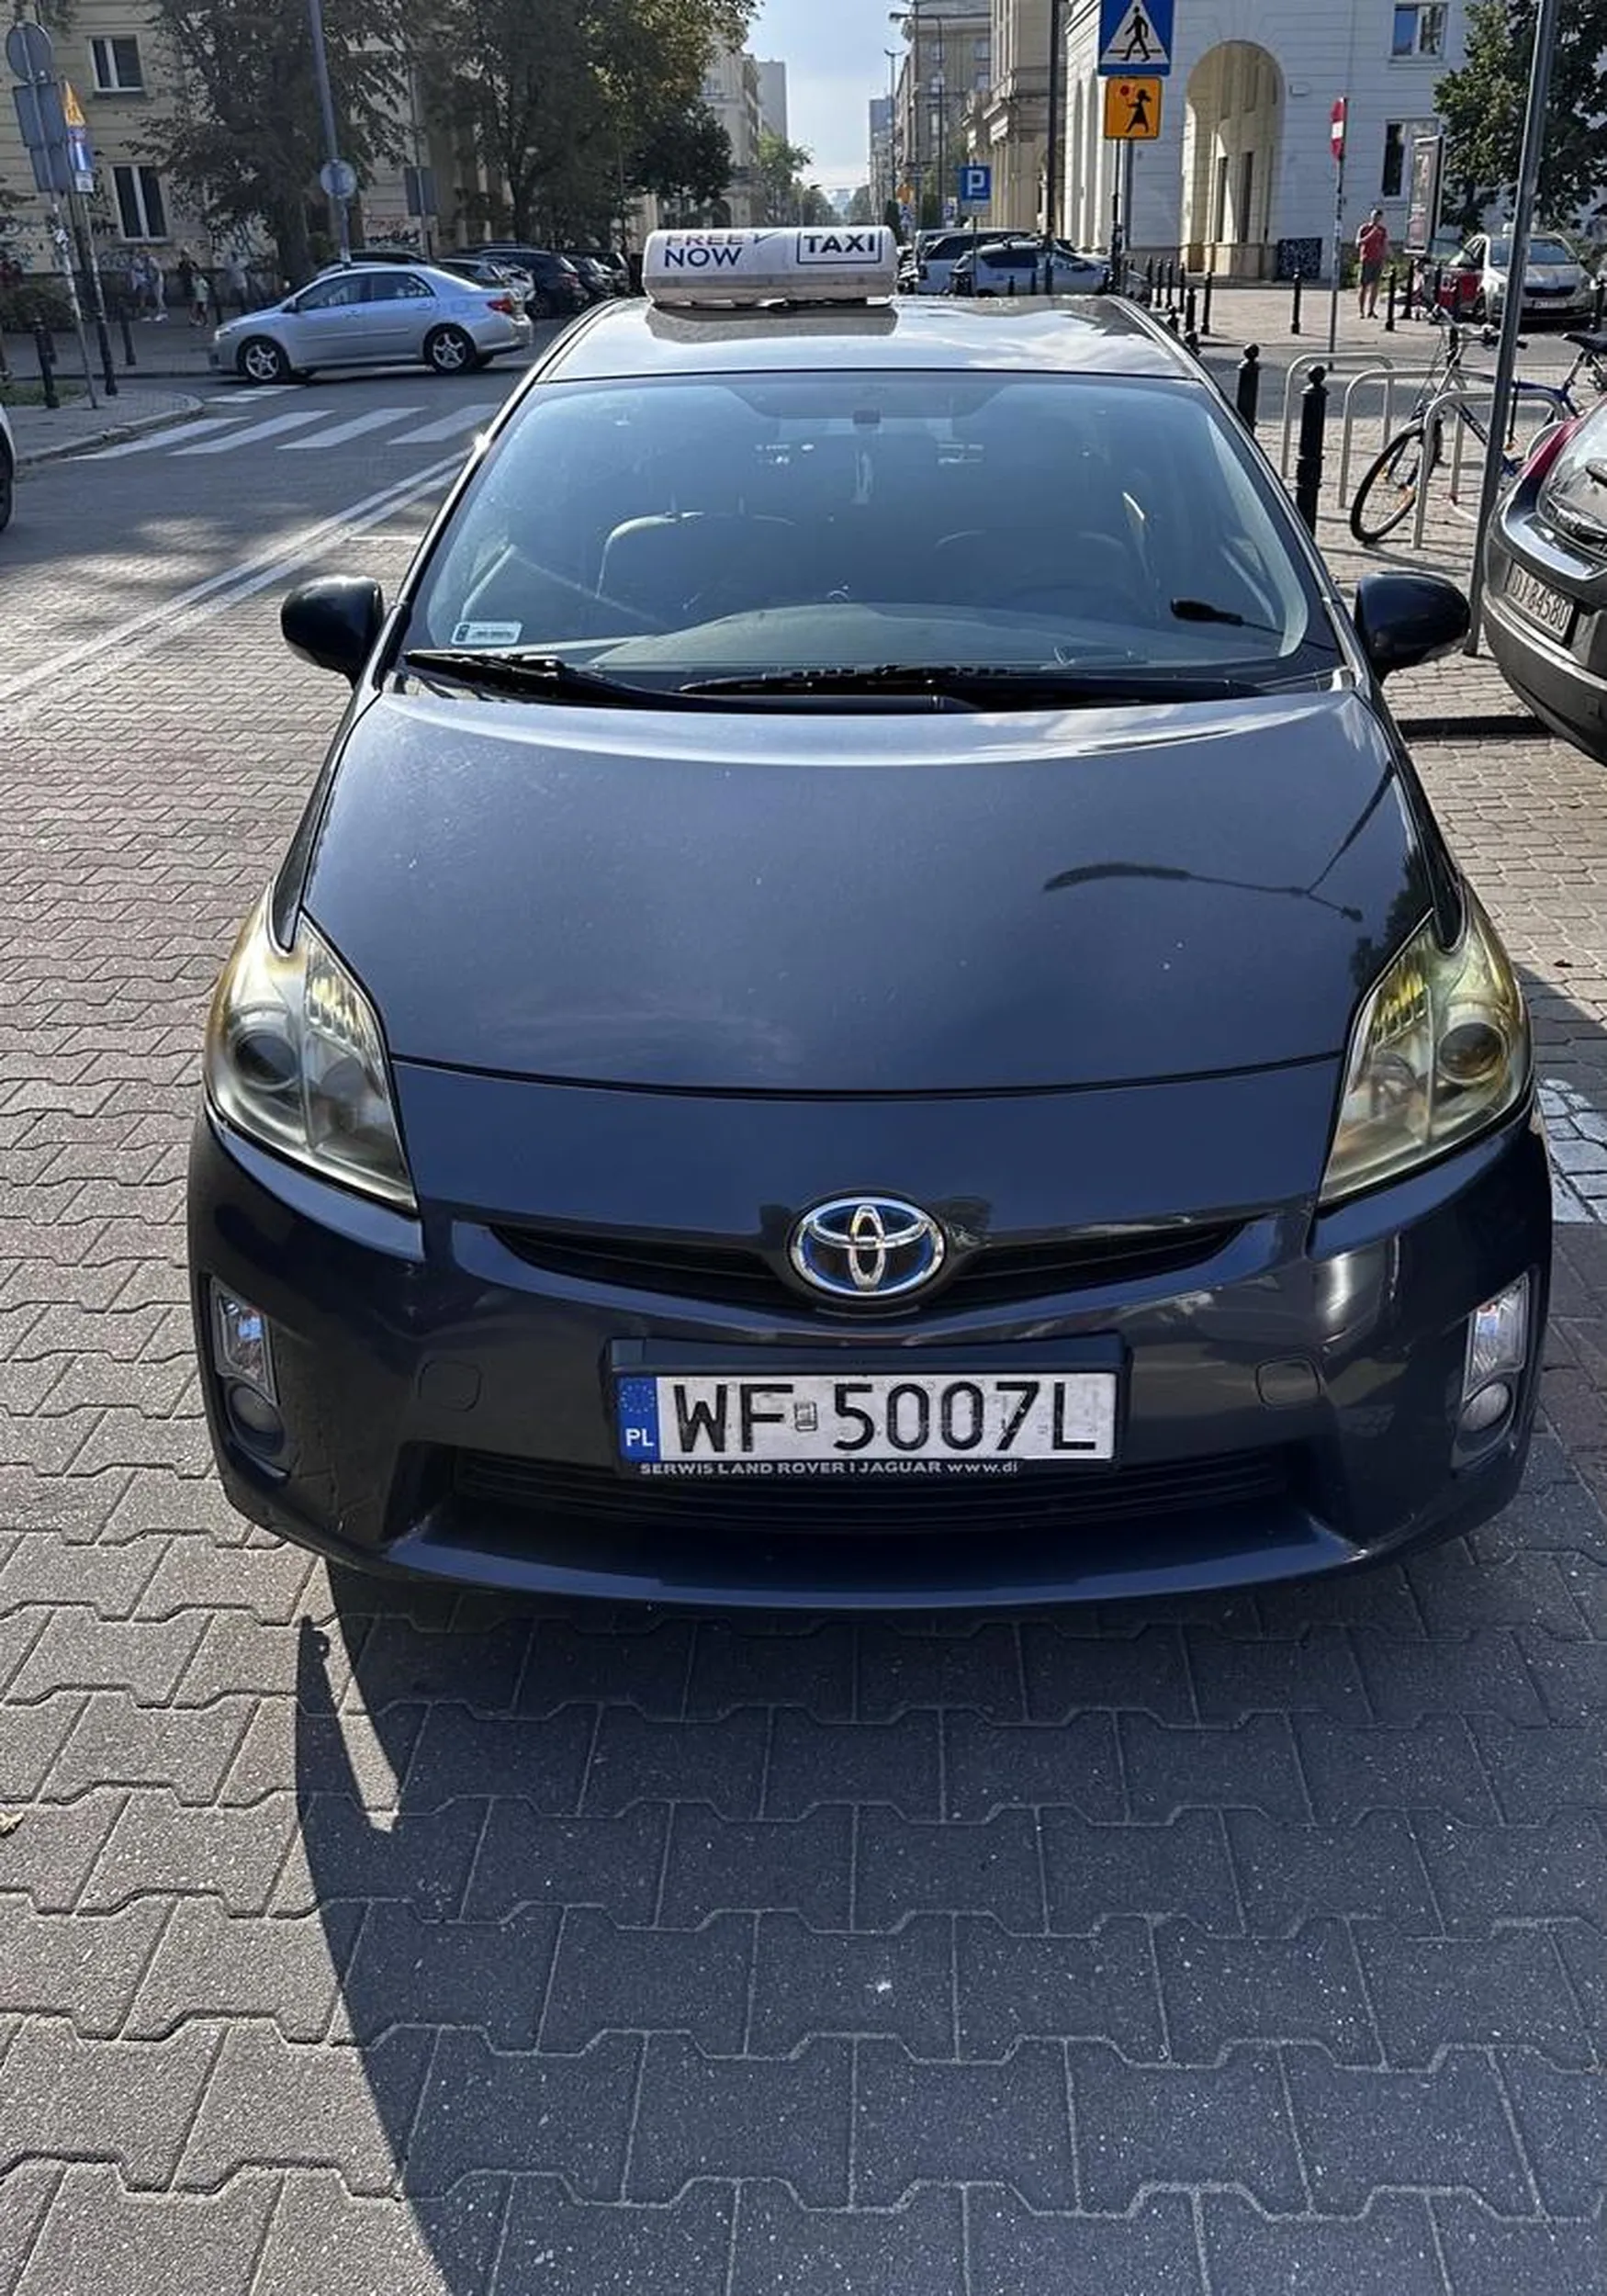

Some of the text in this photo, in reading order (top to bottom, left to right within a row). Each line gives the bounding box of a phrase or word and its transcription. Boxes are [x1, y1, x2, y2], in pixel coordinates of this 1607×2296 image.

[967, 170, 984, 196] P
[666, 232, 745, 246] FREE
[804, 234, 875, 254] TAXI
[664, 247, 742, 268] NOW
[672, 1380, 1096, 1453] WF 5007L
[625, 1427, 655, 1447] PL
[640, 1463, 713, 1475] SERWIS
[718, 1463, 773, 1474] LAND
[778, 1462, 846, 1474] ROVER
[859, 1461, 941, 1473] JAGUAR
